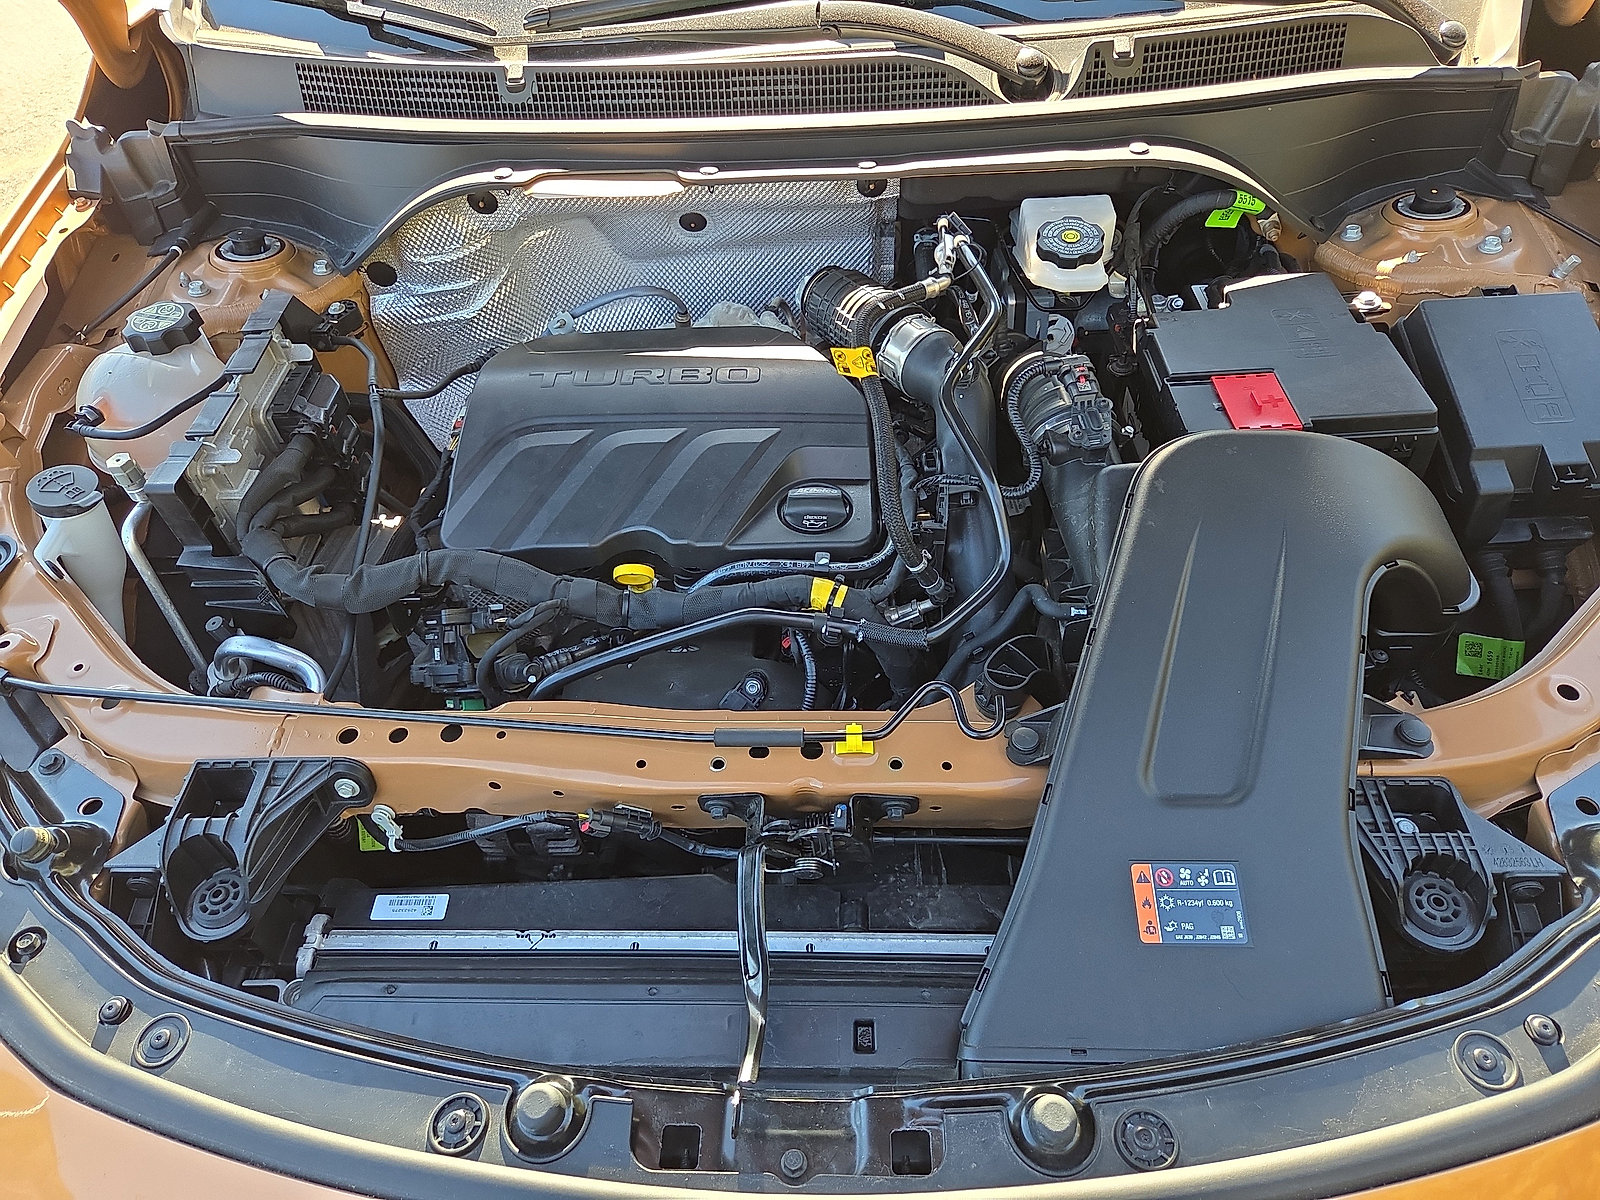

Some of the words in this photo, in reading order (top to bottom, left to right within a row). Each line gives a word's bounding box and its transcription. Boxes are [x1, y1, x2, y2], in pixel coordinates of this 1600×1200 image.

[1238, 194, 1256, 206] 5515
[529, 366, 761, 388] TURBO
[1486, 650, 1494, 665] 1659
[1176, 899, 1204, 908] R-1234yf
[1225, 899, 1233, 908] kg
[1181, 922, 1194, 930] PAG
